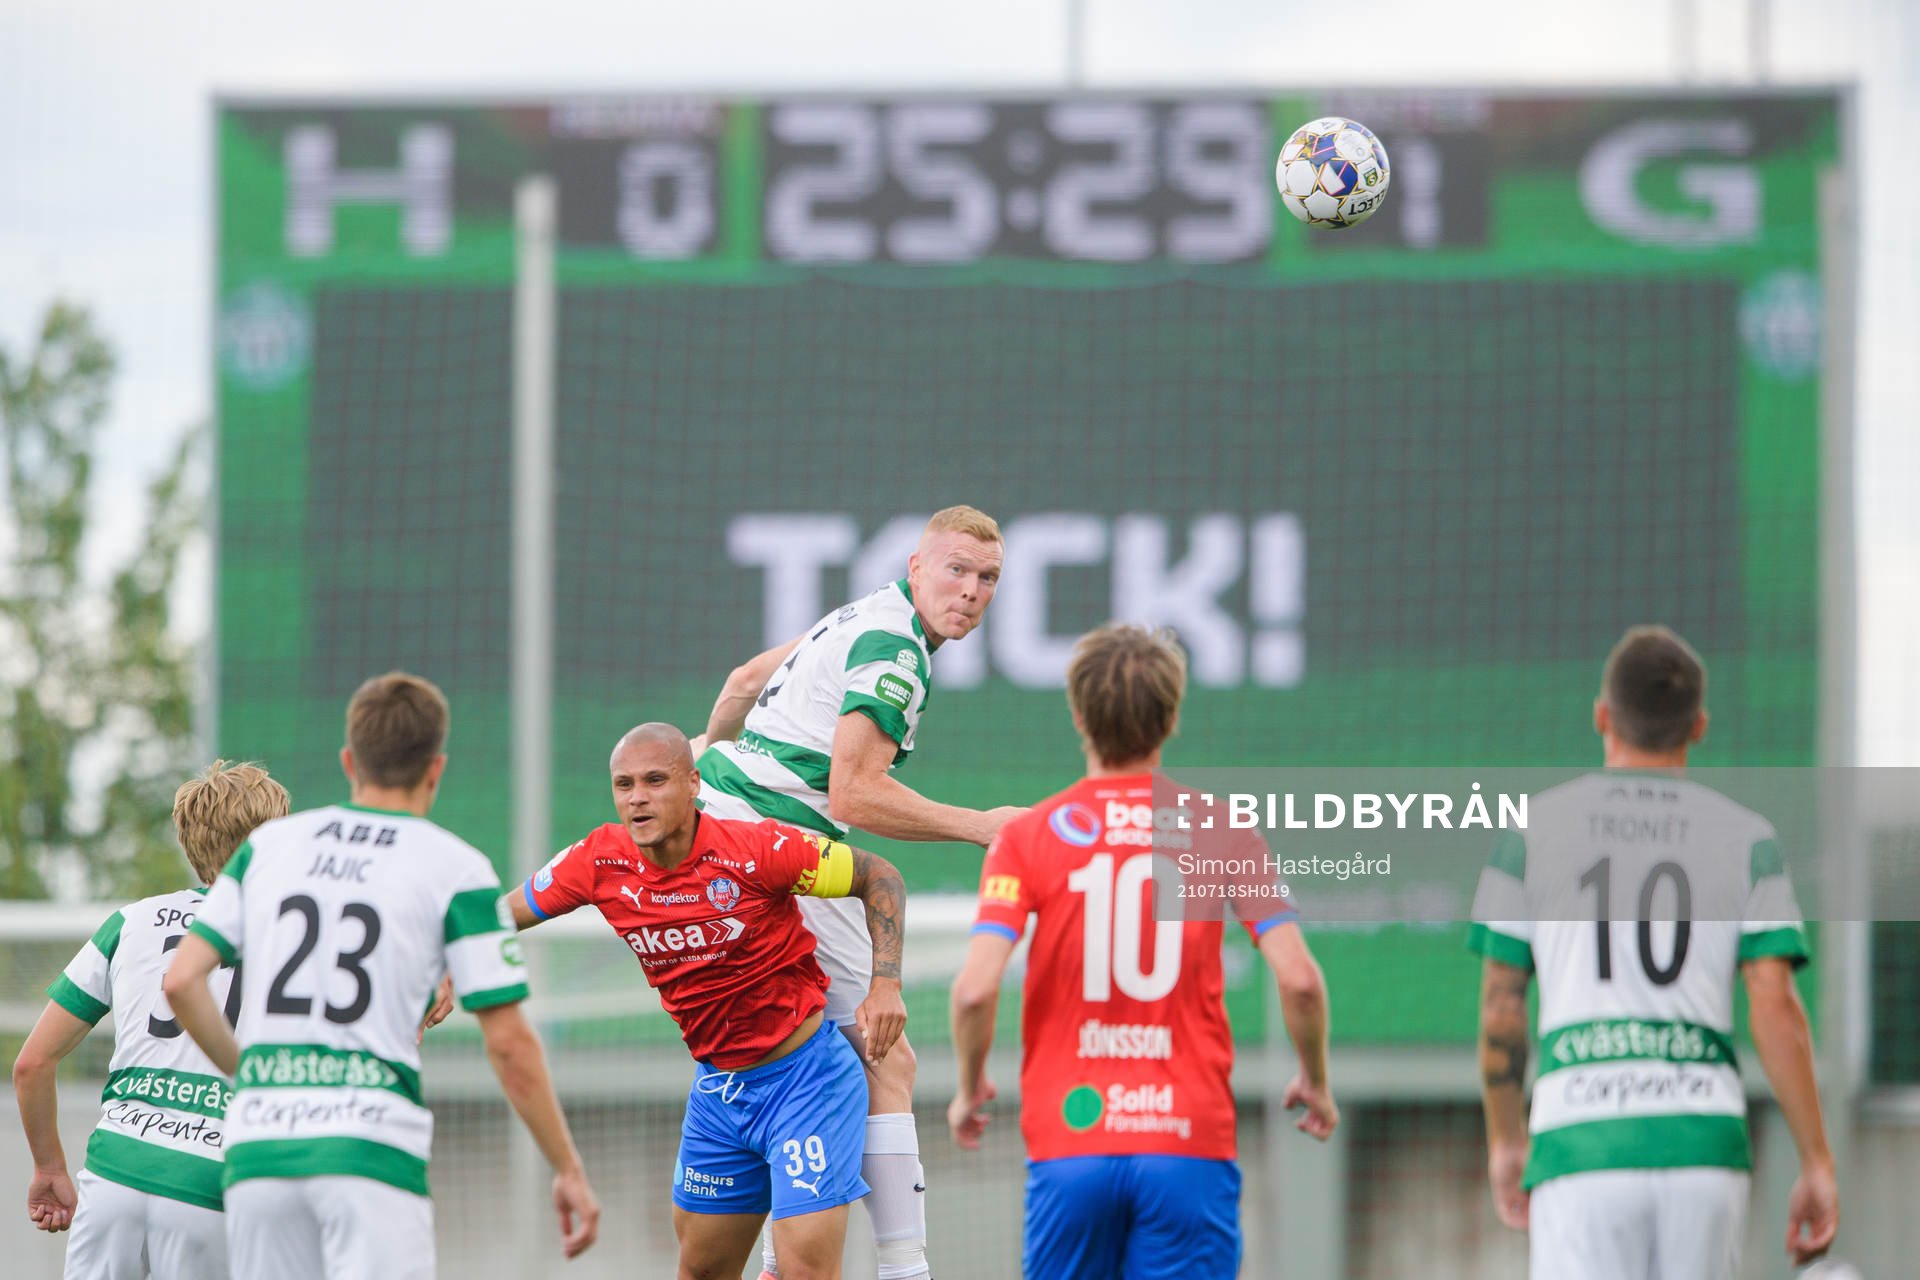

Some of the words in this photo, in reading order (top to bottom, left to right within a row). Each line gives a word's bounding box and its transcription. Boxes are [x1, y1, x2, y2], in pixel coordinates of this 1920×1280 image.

[284, 124, 453, 258] H
[618, 144, 713, 260] 0
[766, 102, 1273, 264] 25:29
[1580, 120, 1762, 248] G
[315, 821, 398, 846] ABB
[308, 853, 374, 883] JAJIC
[651, 892, 700, 904] kondektor
[627, 924, 708, 955] akea
[1067, 852, 1186, 1003] 10
[1579, 857, 1692, 987] 10
[266, 894, 381, 1024] 23
[1077, 1020, 1172, 1060] JÖNSSON
[1106, 1083, 1174, 1113] Solid
[783, 1135, 826, 1177] 39
[684, 1179, 718, 1197] Bank
[685, 1167, 734, 1187] Resurs
